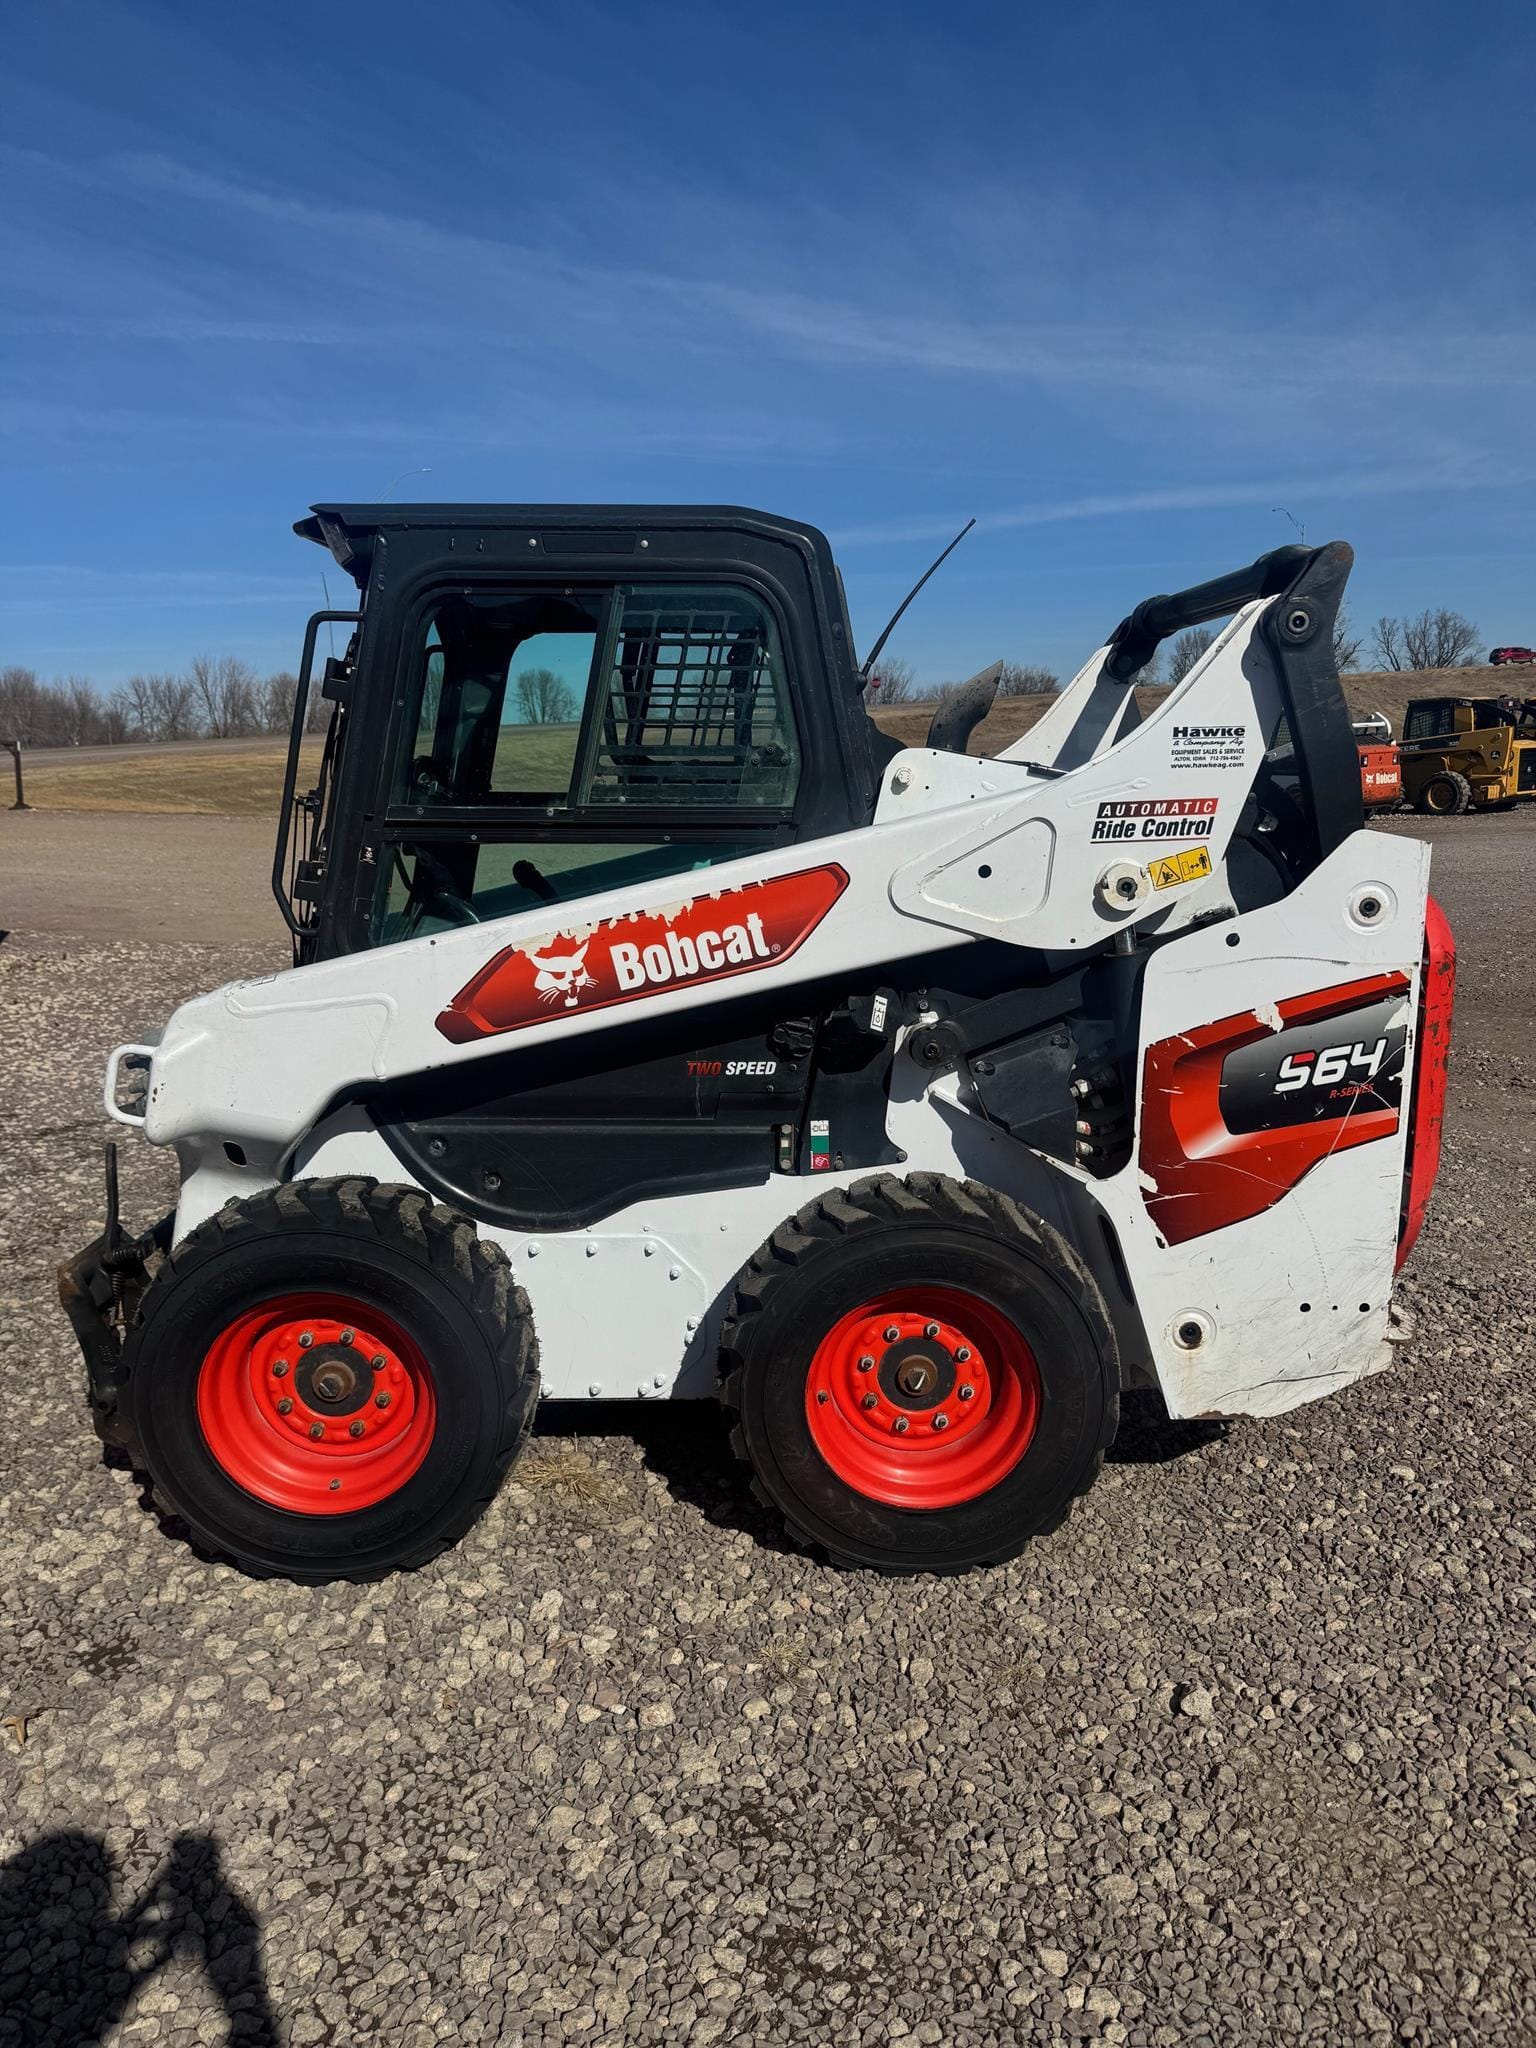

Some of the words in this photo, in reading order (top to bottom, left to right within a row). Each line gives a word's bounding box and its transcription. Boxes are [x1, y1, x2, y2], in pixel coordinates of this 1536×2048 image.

[1173, 726, 1245, 738] Hawke
[1183, 738, 1226, 747] Company
[1171, 748, 1202, 756] EQUIPMENT
[1102, 800, 1214, 817] AUTOMATIC
[1092, 820, 1136, 839] Ride
[1142, 817, 1215, 837] Control
[609, 912, 771, 992] Bobcat
[687, 1061, 722, 1076] TWO
[725, 1061, 777, 1076] SPEED
[1275, 1039, 1387, 1092] S64
